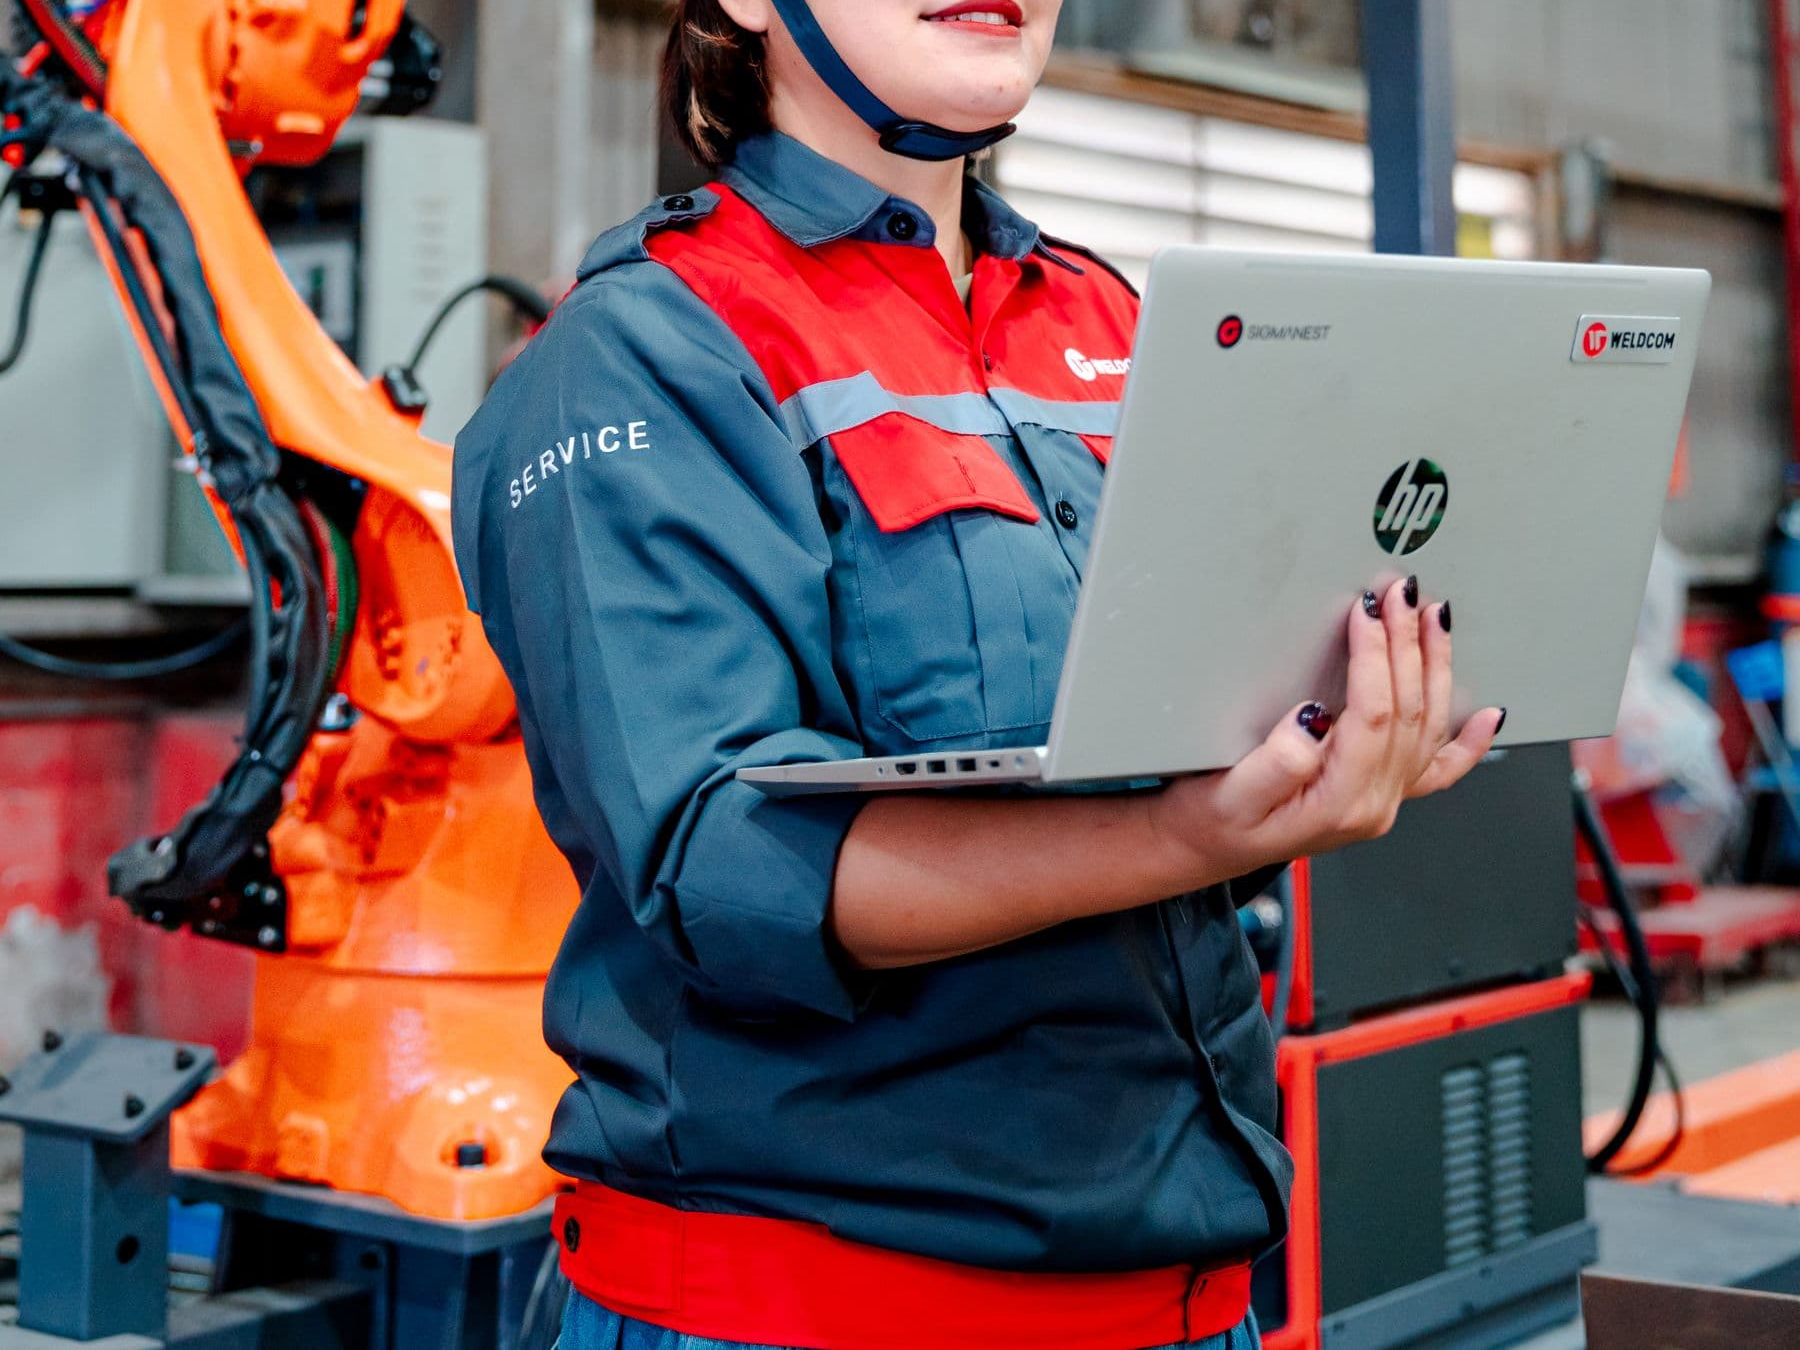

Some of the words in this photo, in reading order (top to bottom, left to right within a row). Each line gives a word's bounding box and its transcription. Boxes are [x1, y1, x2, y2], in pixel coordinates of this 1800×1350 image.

[1247, 324, 1332, 341] SIGMANEST
[1610, 331, 1676, 349] WELDCOM
[509, 420, 650, 509] SERVICE
[1376, 458, 1446, 555] hp
